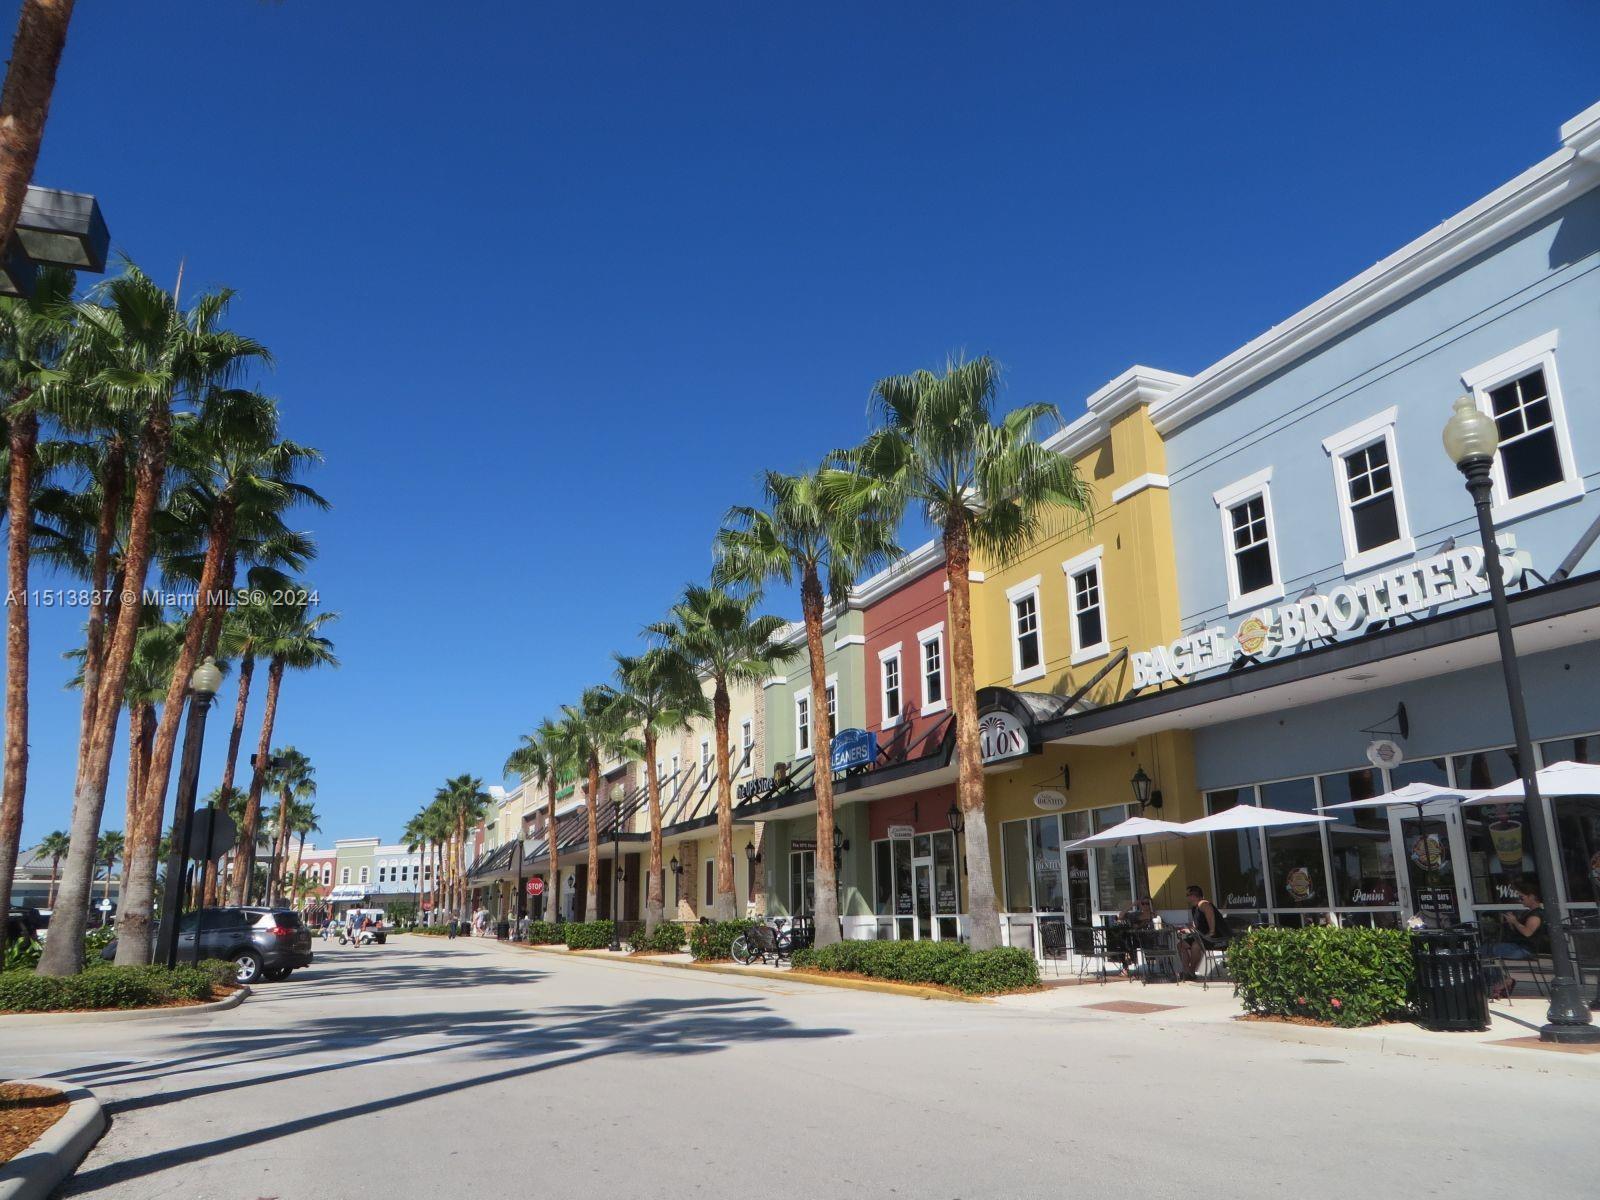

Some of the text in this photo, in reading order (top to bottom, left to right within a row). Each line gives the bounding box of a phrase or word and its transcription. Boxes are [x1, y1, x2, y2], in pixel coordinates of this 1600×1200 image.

[1131, 626, 1233, 690] BAGEL
[981, 727, 1021, 759] LON
[831, 744, 868, 767] LEANERS
[746, 779, 757, 796] UPS
[758, 777, 773, 793] Store
[528, 882, 543, 890] STOP
[1227, 893, 1257, 907] Catering
[1352, 888, 1385, 903] Panini
[1437, 893, 1450, 901] DAYS
